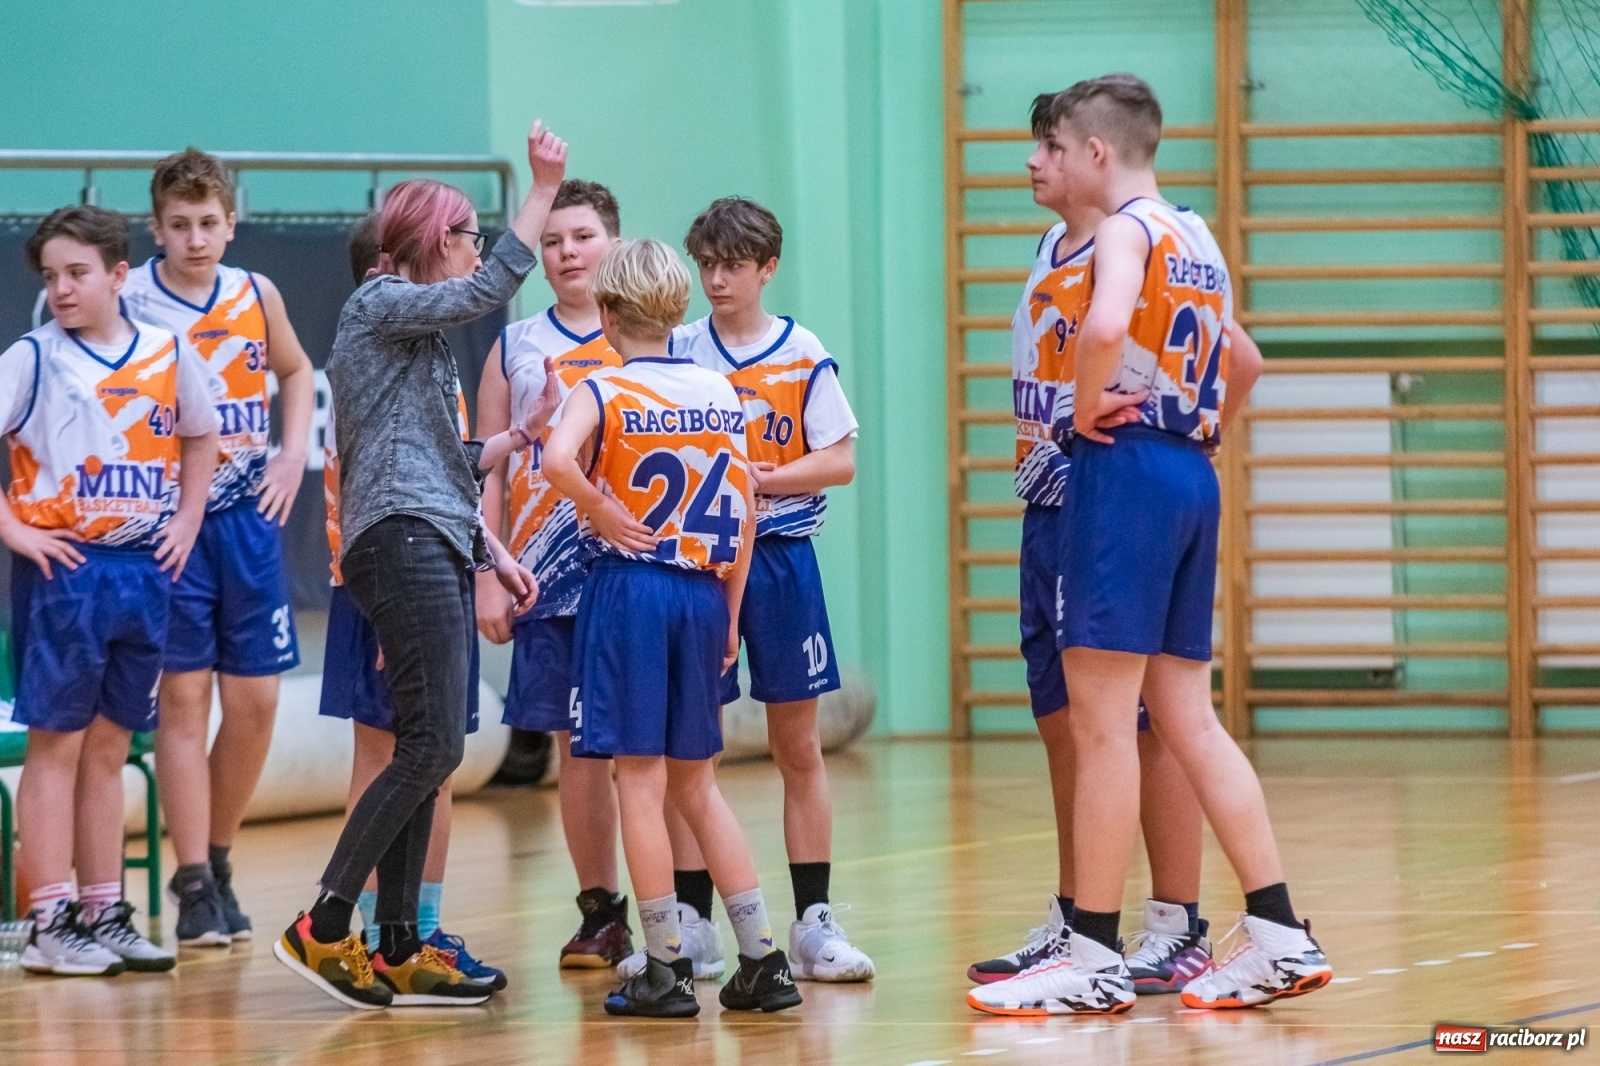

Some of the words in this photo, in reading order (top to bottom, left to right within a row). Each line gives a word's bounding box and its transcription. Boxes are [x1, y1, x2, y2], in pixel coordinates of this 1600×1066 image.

[559, 360, 603, 368] regio
[148, 404, 173, 436] 40
[216, 400, 265, 436] INI
[622, 402, 745, 435] RACIBÓRZ
[763, 411, 793, 446] 10
[76, 464, 165, 500] MINI
[632, 451, 741, 564] 24
[802, 631, 828, 677] 10
